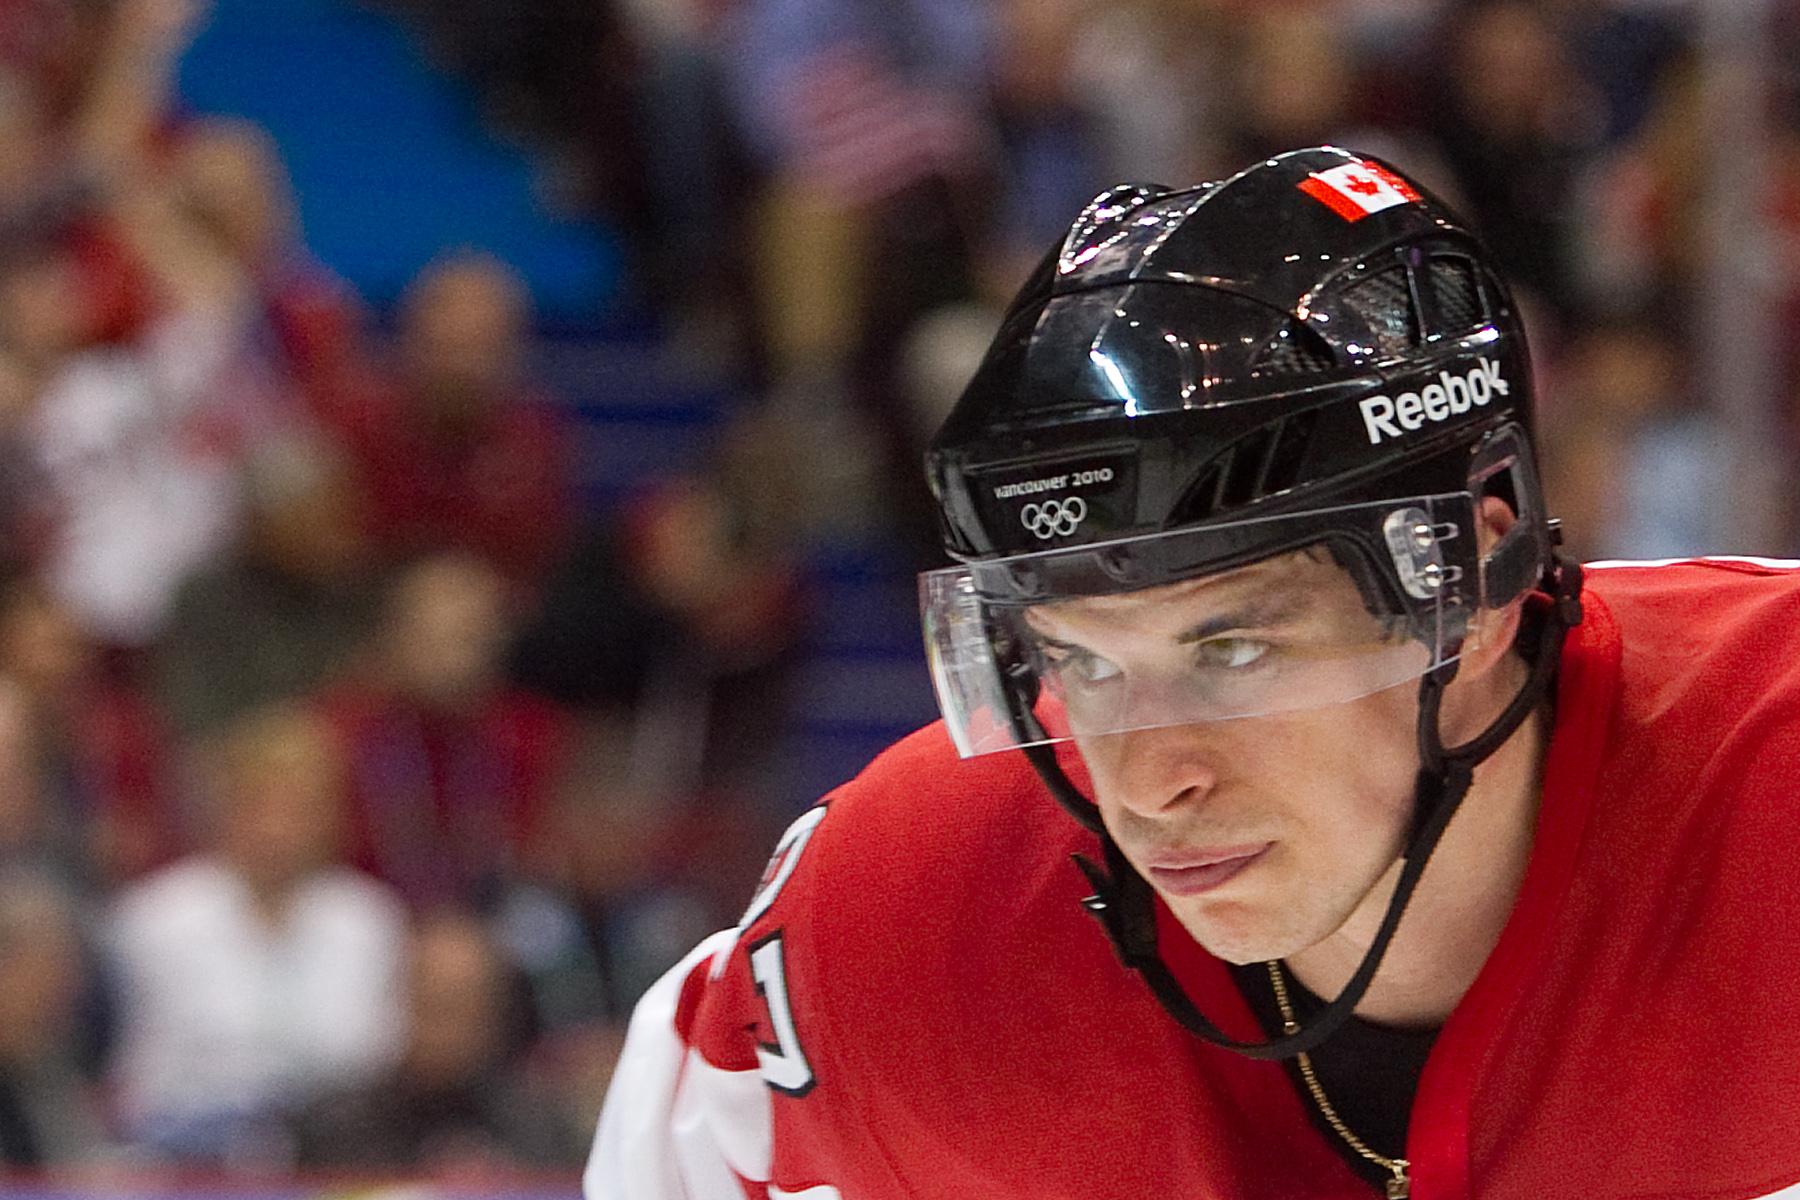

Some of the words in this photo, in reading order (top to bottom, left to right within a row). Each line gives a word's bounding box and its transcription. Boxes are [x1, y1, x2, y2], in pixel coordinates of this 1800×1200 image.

[1358, 356, 1510, 445] Reebok
[993, 474, 1070, 499] vancouver
[1072, 468, 1114, 487] 2010
